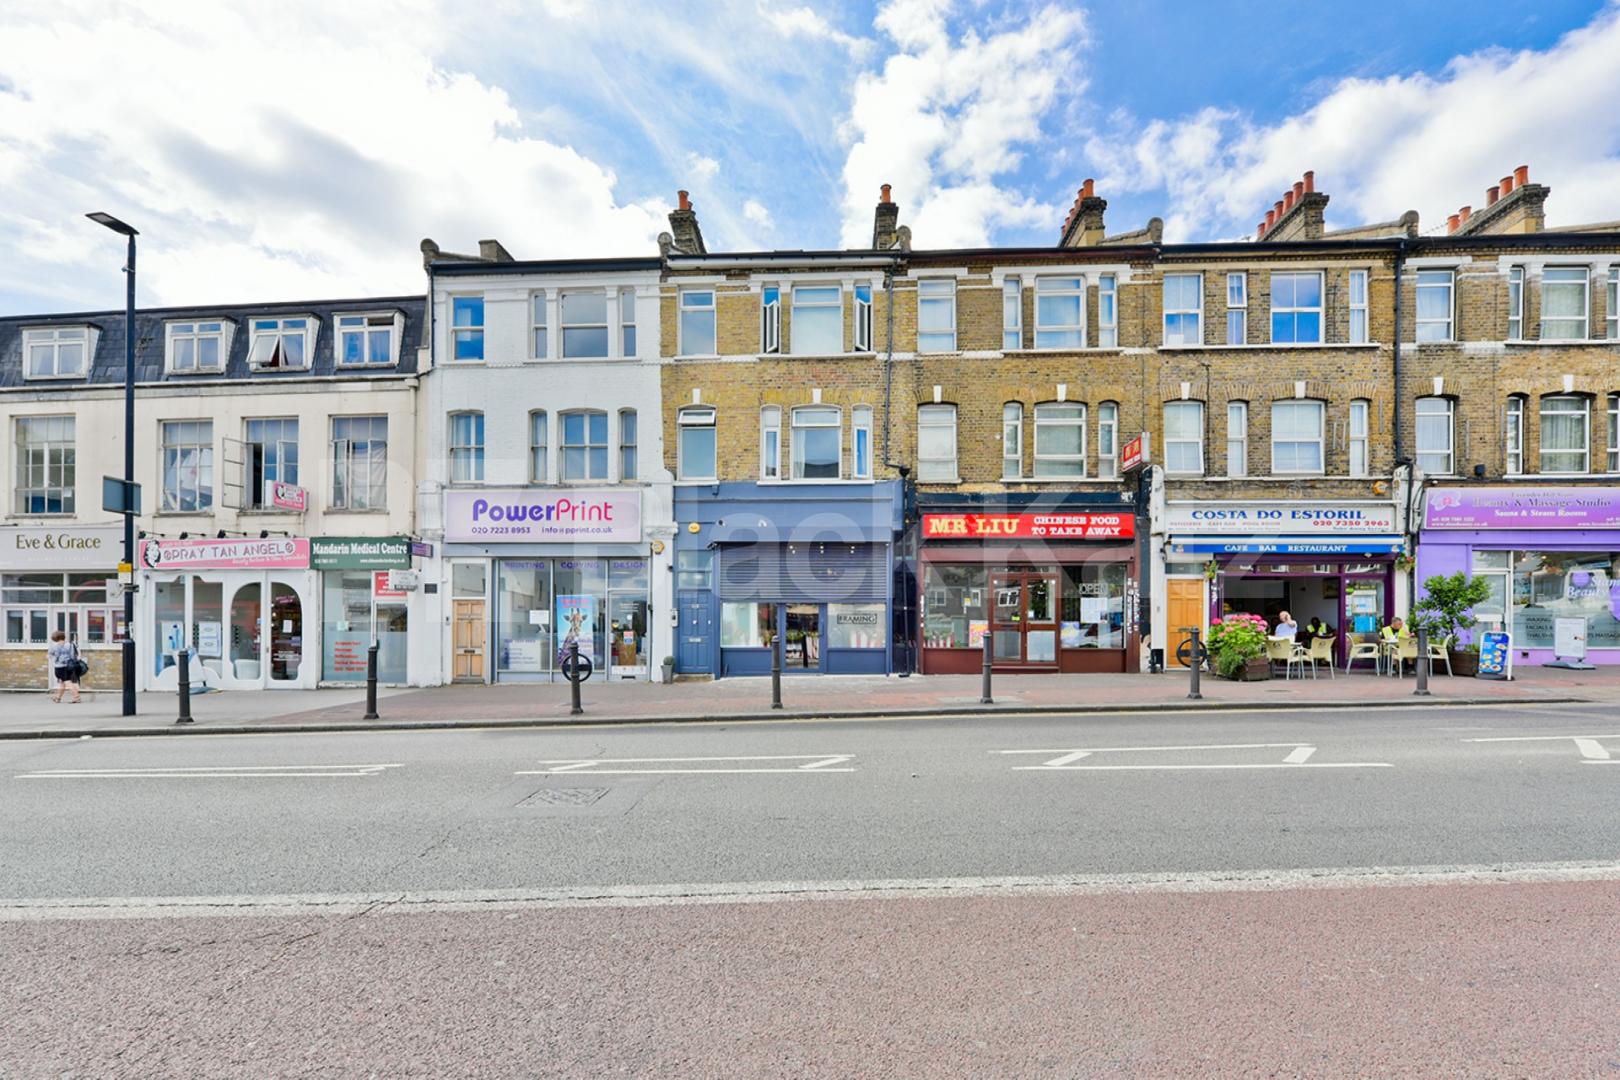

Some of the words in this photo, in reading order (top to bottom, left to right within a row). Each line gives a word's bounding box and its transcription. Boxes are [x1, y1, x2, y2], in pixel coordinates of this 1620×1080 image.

[1575, 498, 1611, 507] Studio
[1191, 510, 1248, 520] COSTA
[1257, 510, 1282, 520] DO
[1290, 510, 1366, 520] ESTORIL
[1494, 509, 1519, 517] Sauna
[1530, 509, 1556, 517] Steam
[1033, 516, 1087, 525] CHINESE
[1090, 516, 1120, 525] FOOD
[471, 526, 488, 535] 020
[490, 526, 509, 535] 7223
[511, 526, 531, 535] 8953
[929, 518, 968, 534] MR
[975, 518, 1020, 534] LIU
[1031, 526, 1047, 535] TO
[1049, 526, 1083, 535] TAKE
[1085, 526, 1121, 535] AWAY
[16, 534, 40, 549] Eve
[44, 534, 55, 549] &
[58, 533, 101, 549] Grace
[212, 546, 237, 558] TAN
[312, 542, 350, 554] Mandarin
[350, 542, 380, 554] Medical
[381, 542, 407, 554] Centre
[504, 561, 545, 569] PRINTING
[613, 561, 646, 569] DESIGN
[1079, 583, 1108, 594] OPEN
